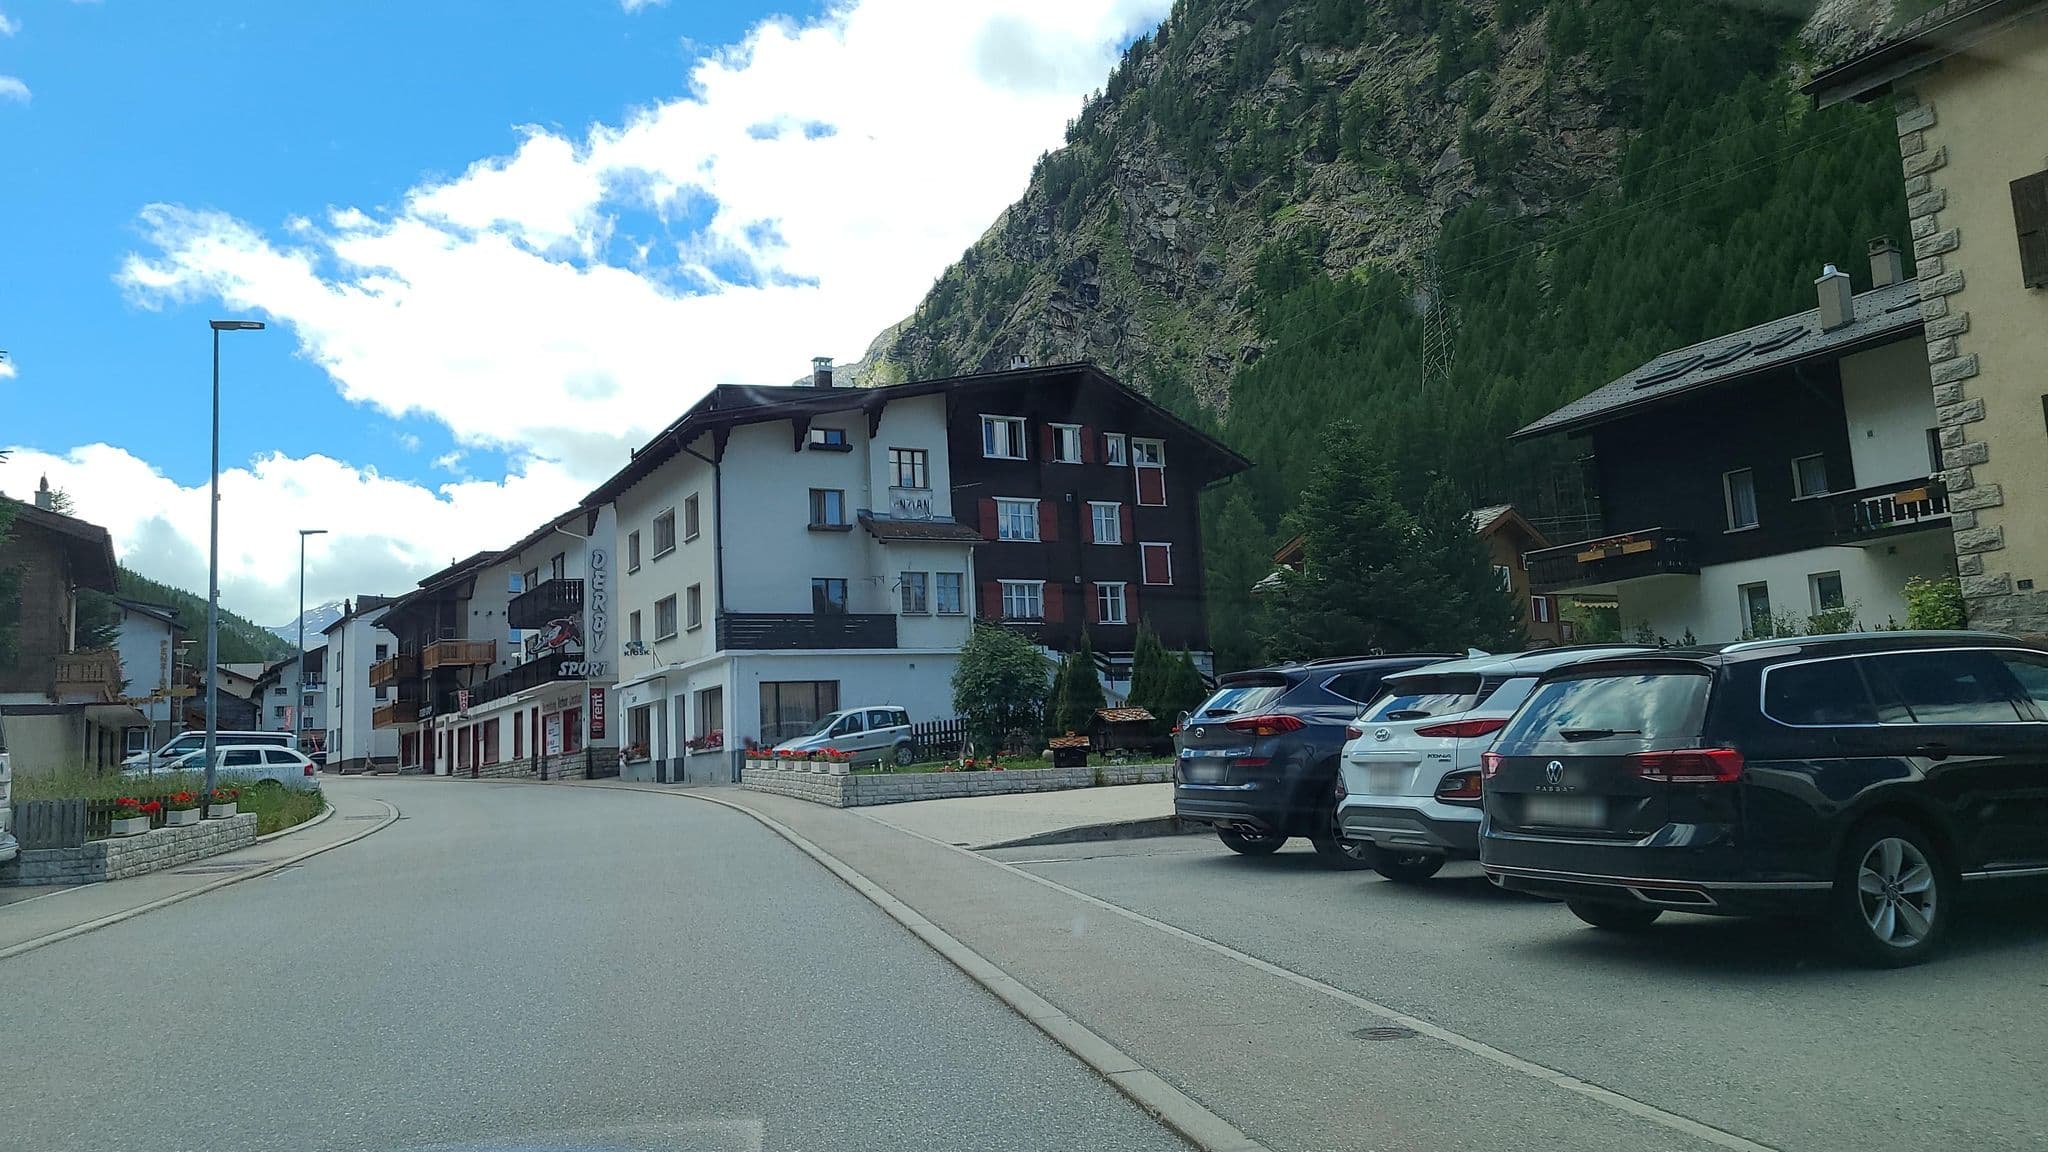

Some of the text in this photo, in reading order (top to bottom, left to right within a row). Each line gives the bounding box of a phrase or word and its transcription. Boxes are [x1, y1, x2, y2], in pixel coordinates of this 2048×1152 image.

[592, 549, 608, 653] DERBY
[624, 649, 650, 657] KIOSK
[558, 661, 608, 677] SPORT
[592, 693, 603, 720] rent
